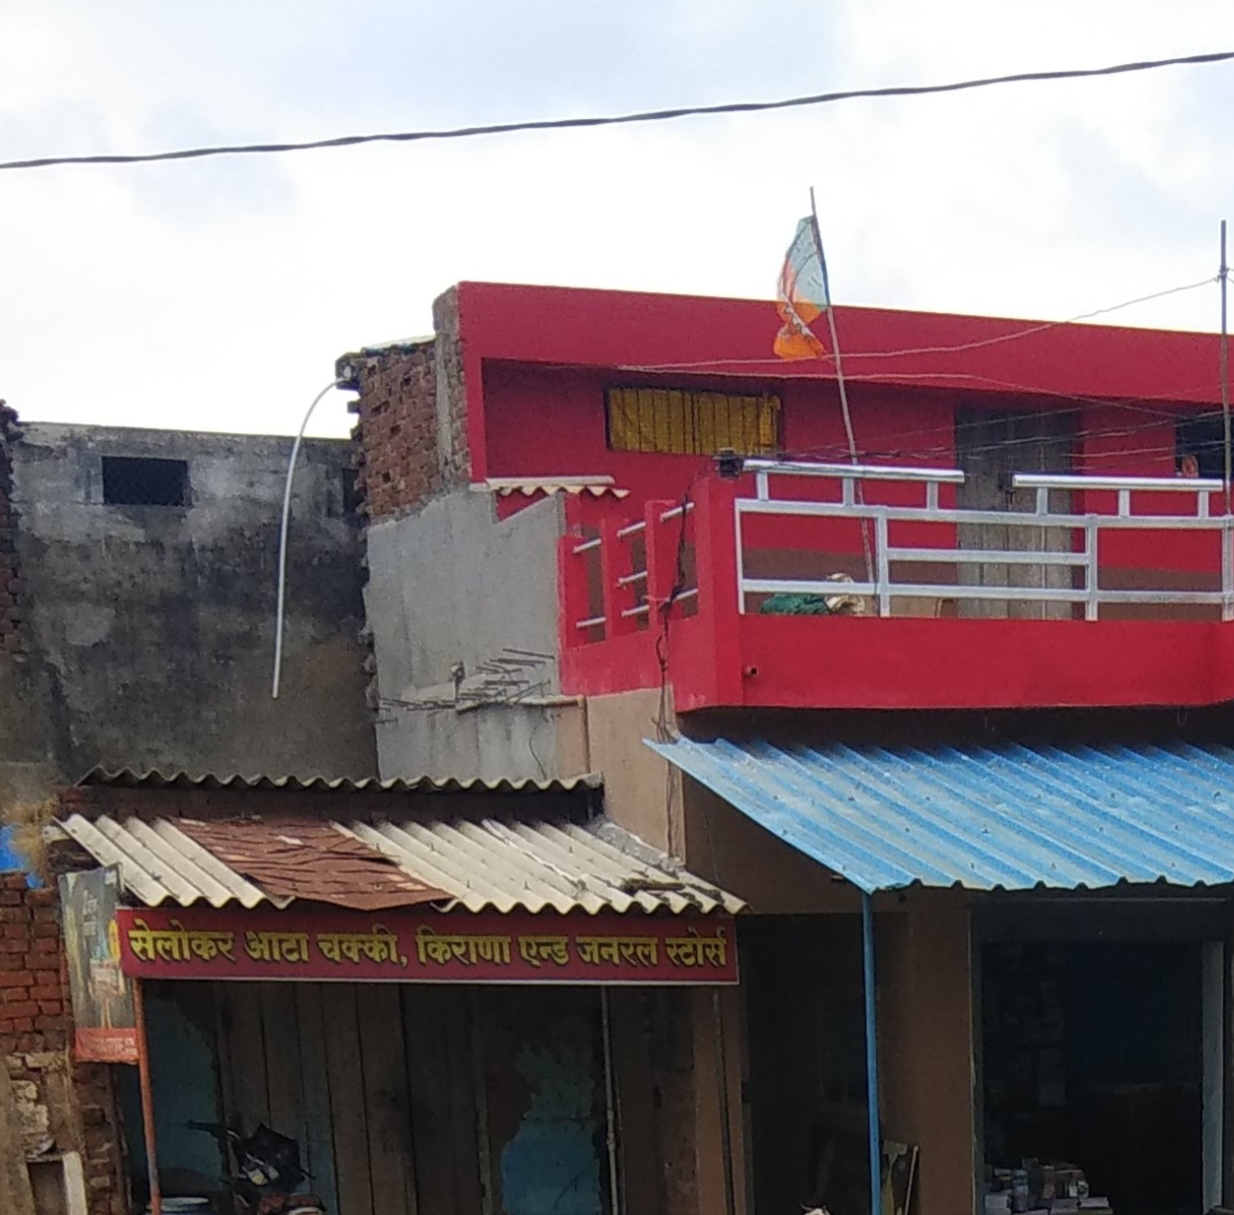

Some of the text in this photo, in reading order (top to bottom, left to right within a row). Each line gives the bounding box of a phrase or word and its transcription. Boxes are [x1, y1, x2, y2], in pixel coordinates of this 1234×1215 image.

[128, 918, 236, 962] सेलोकर
[244, 930, 309, 962] आटा
[415, 924, 512, 966] किराणा
[518, 935, 568, 966] एन्ड
[576, 936, 658, 966] जनरल
[665, 926, 727, 967] स्टोर्स
